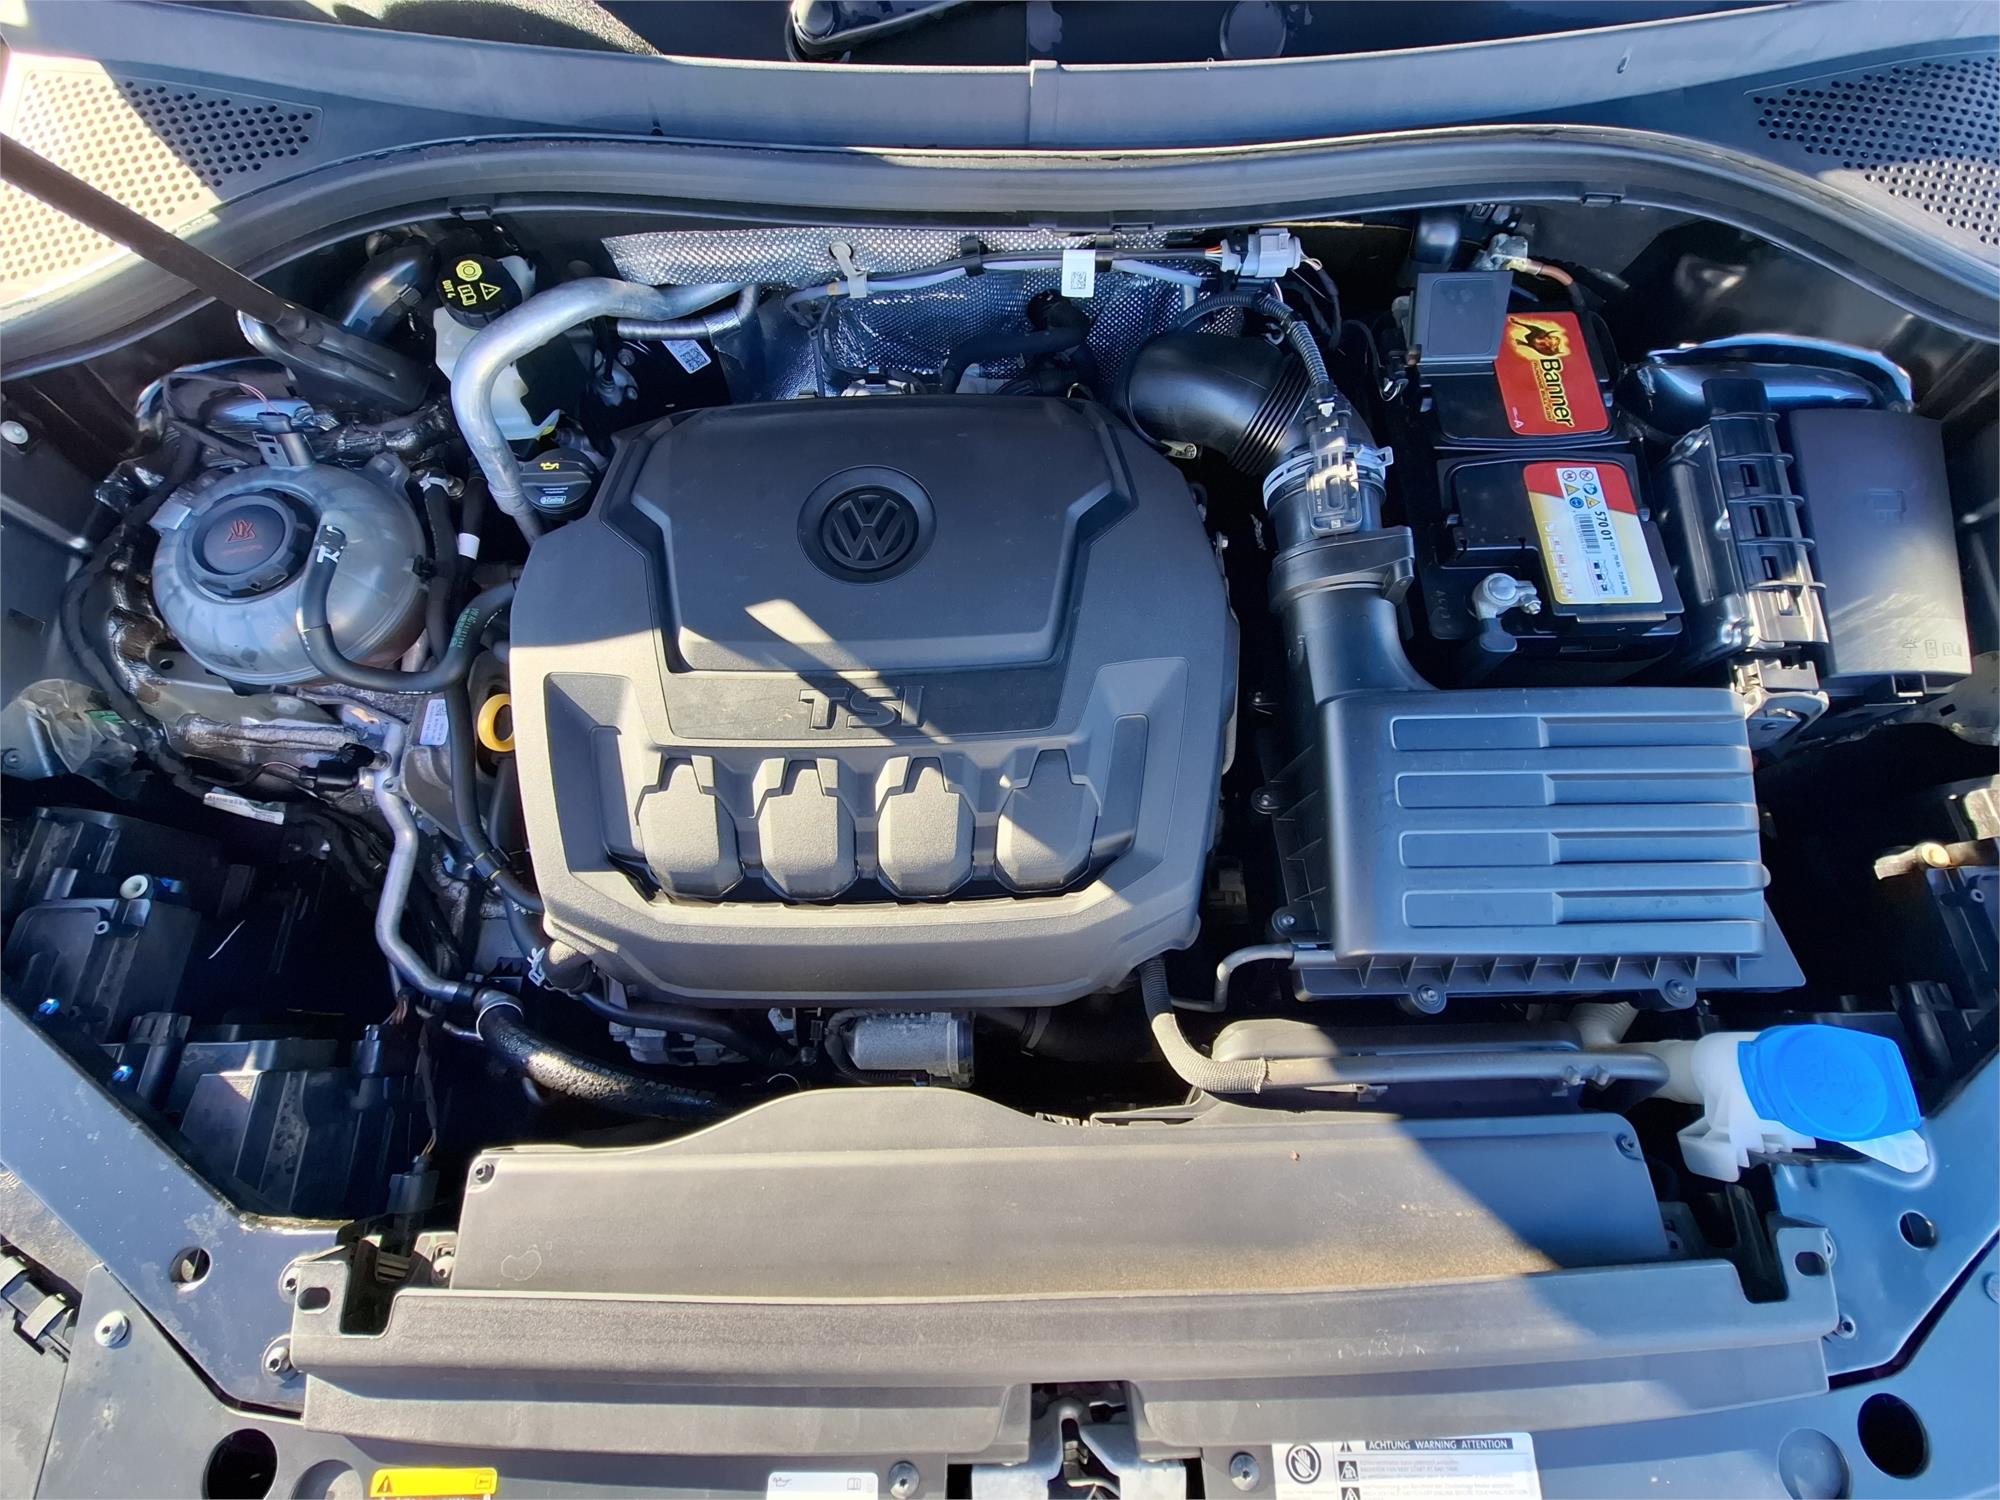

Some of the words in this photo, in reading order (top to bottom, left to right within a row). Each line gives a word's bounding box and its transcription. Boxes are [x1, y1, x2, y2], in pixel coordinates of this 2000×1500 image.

[1540, 359, 1574, 427] Banner
[1594, 511, 1609, 528] 570
[1600, 530, 1613, 541] 01
[799, 685, 924, 729] TSI
[1368, 1440, 1411, 1450] ACHTUNG
[1415, 1439, 1457, 1450] WARNING
[1461, 1439, 1508, 1450] ATTENTION
